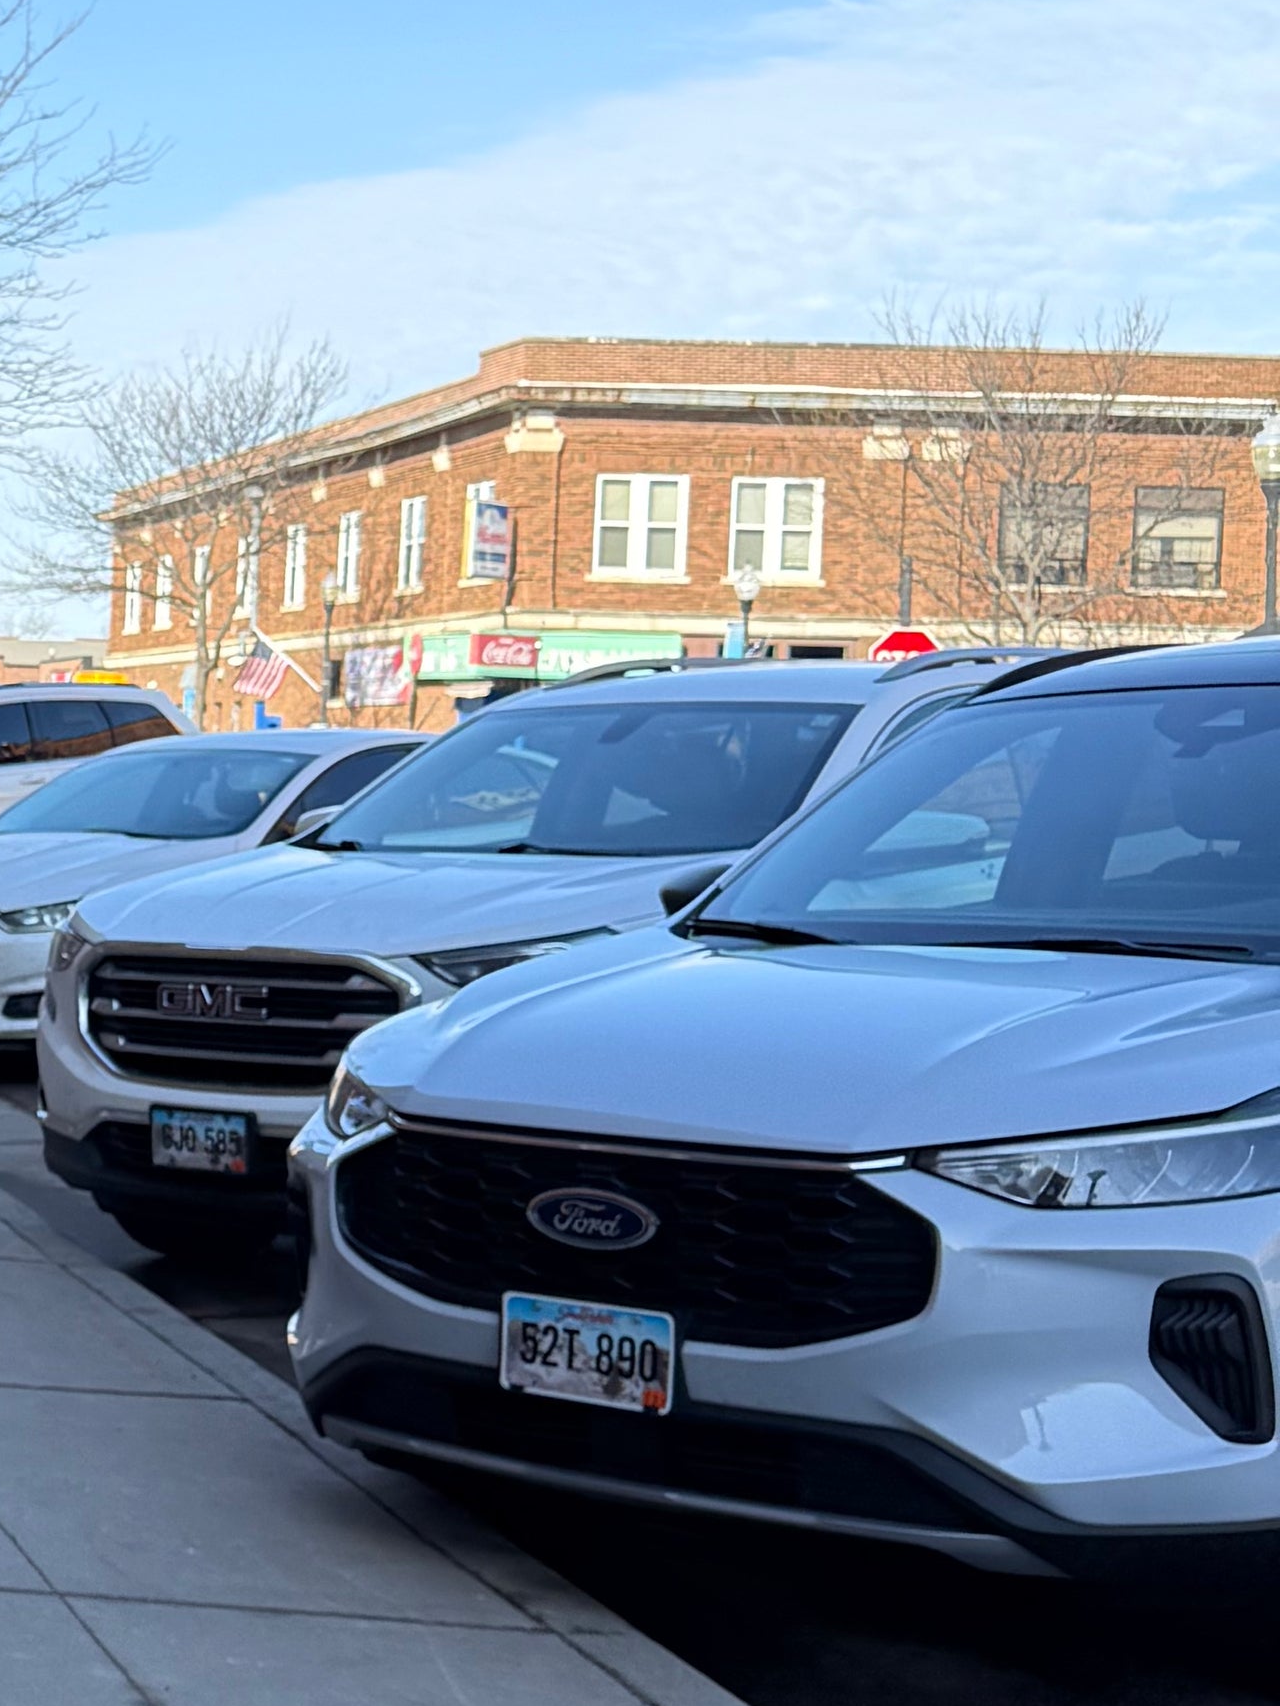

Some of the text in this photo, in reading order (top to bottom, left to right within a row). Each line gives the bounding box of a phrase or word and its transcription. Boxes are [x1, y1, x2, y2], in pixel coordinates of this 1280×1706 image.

[157, 981, 269, 1020] GMC
[553, 1199, 623, 1237] Ford
[520, 1321, 658, 1382] 52T 890
